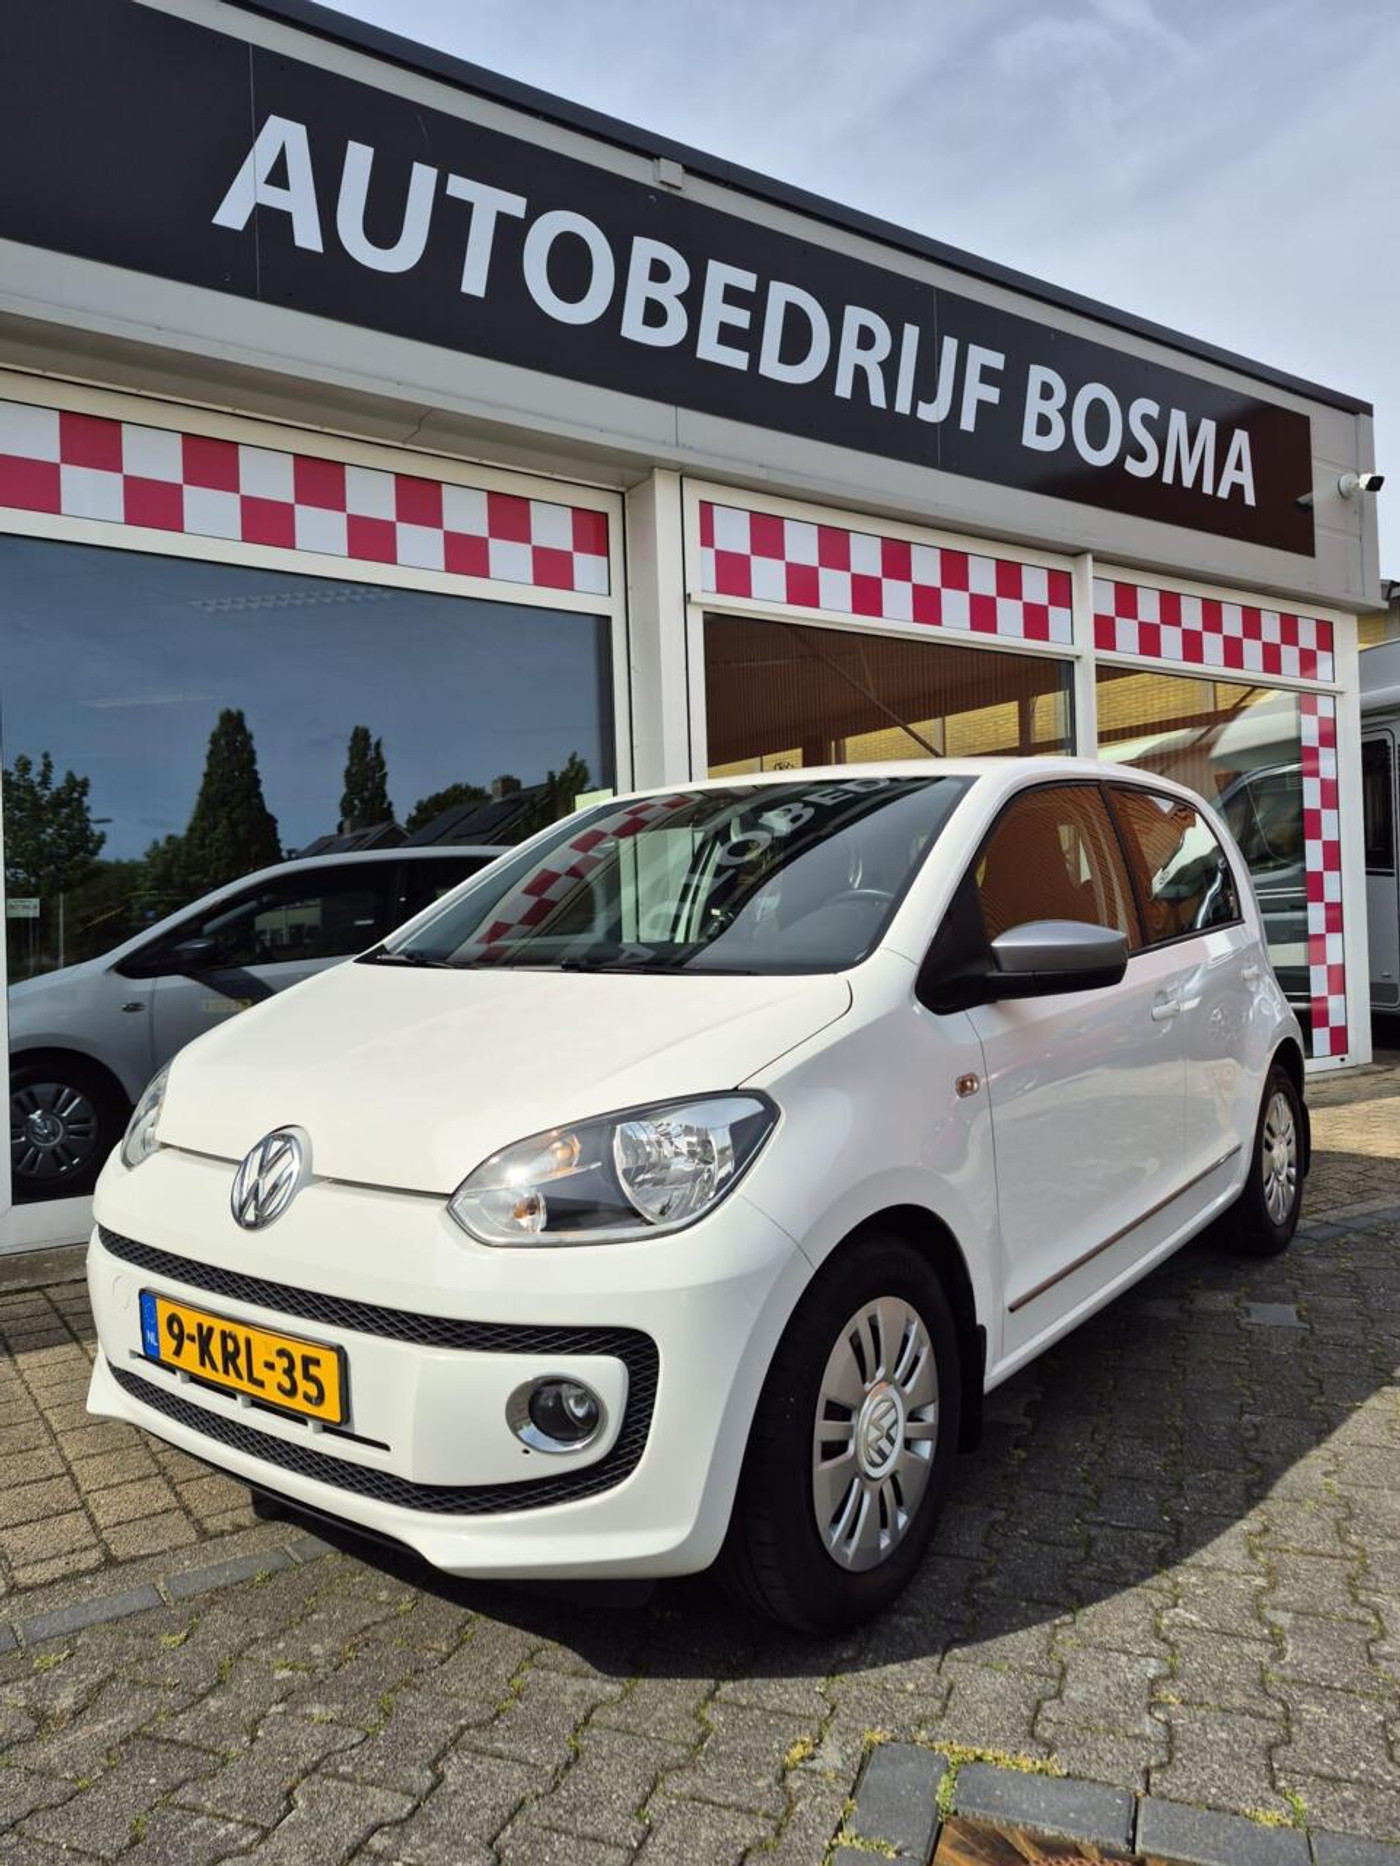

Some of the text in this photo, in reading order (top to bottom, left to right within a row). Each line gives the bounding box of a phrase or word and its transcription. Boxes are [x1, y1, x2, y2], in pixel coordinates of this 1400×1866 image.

[212, 114, 1257, 507] AUTOBEDRIJF BOSMA
[146, 1312, 325, 1407] NL 9-KRL-35
